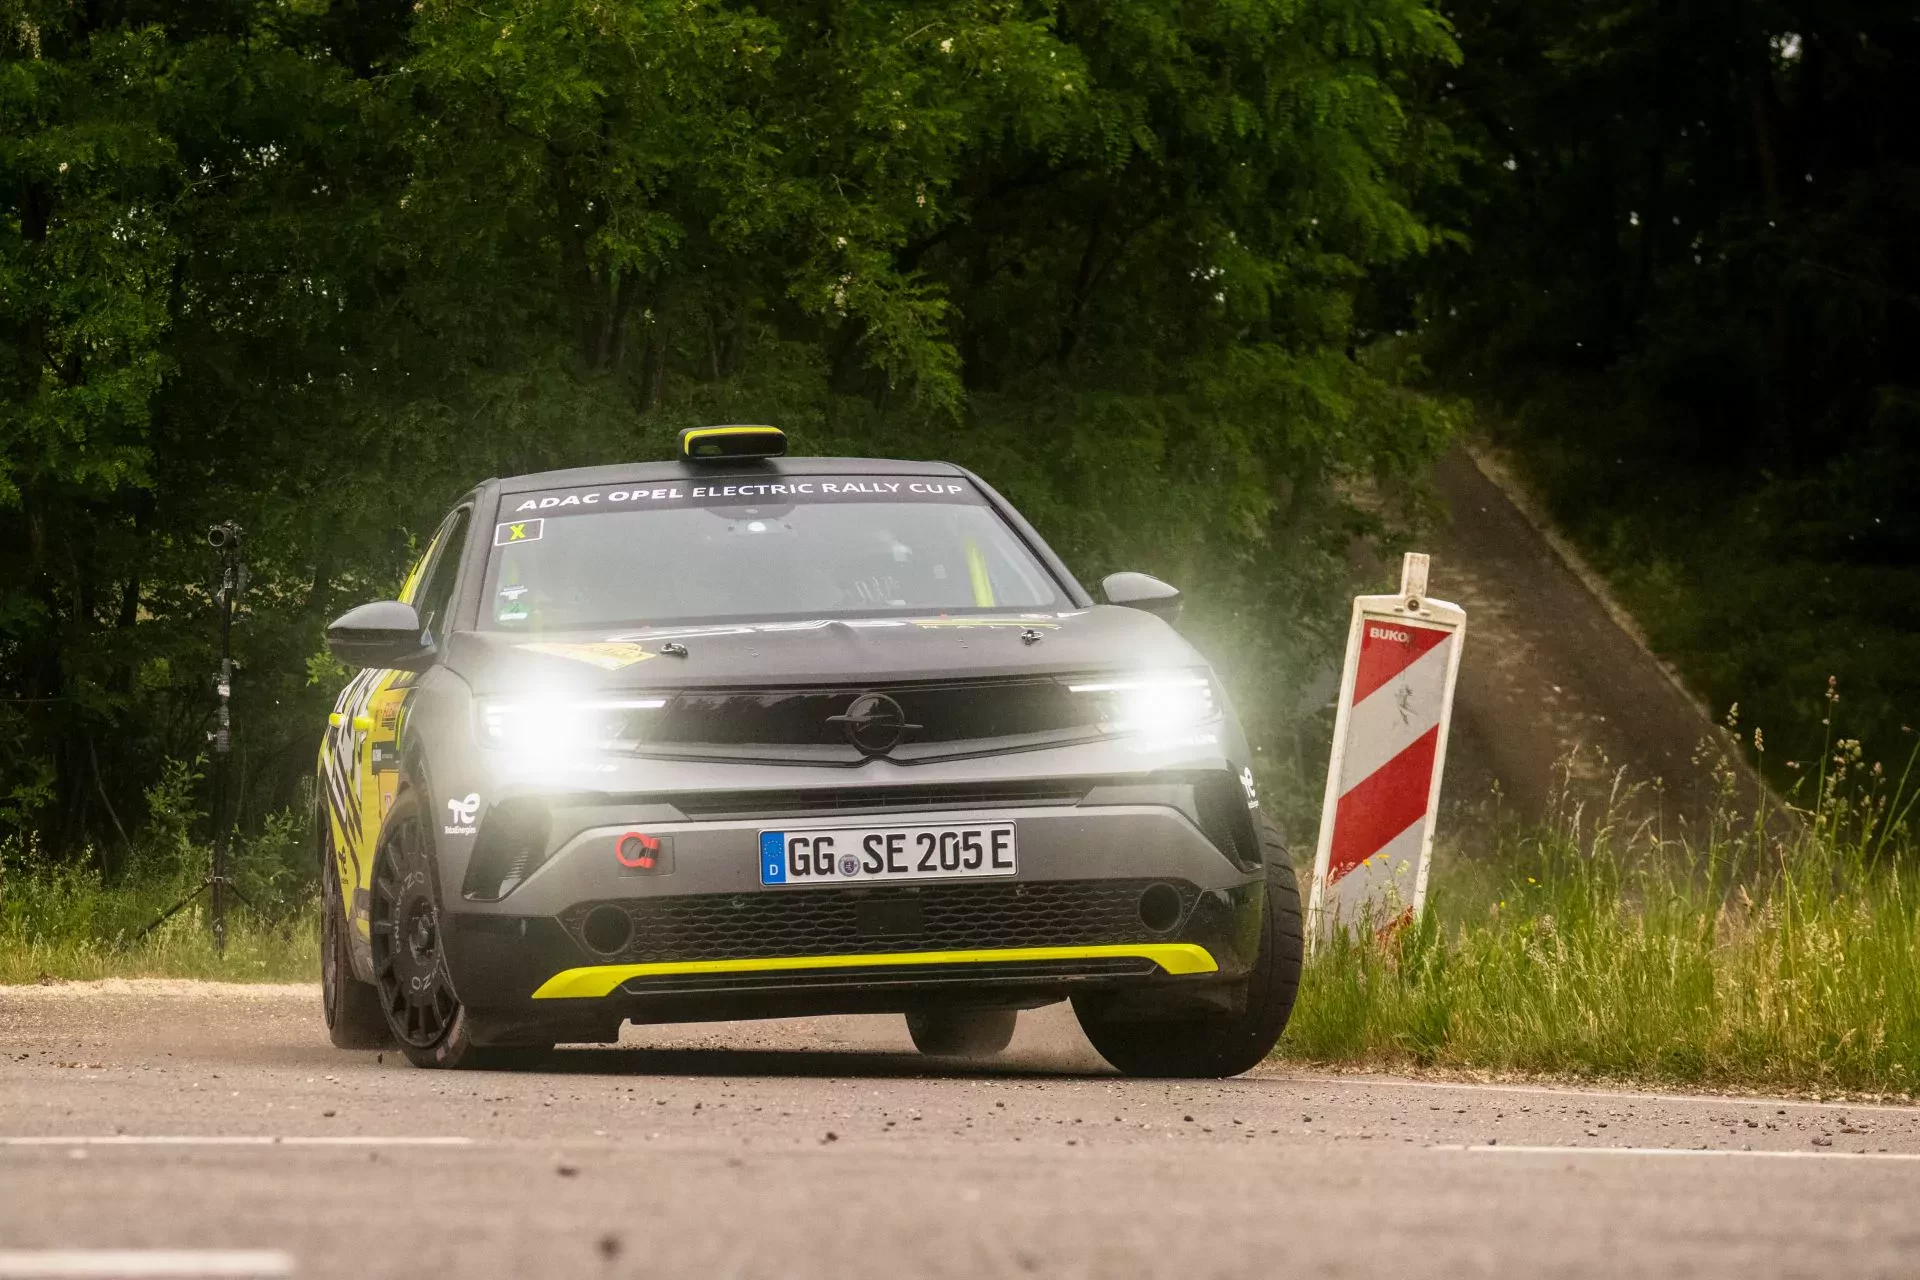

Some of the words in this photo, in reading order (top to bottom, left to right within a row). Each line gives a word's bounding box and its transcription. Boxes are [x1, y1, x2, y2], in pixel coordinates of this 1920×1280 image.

[515, 492, 601, 512] ADAC
[607, 488, 684, 502] OPEL
[692, 483, 814, 498] ELECTRIC
[821, 482, 901, 494] RALLY
[908, 483, 964, 495] CUP
[509, 523, 527, 541] X
[769, 864, 779, 877] D
[788, 836, 835, 876] GG
[862, 833, 909, 874] SE
[916, 831, 984, 872] 205
[990, 829, 1014, 869] E
